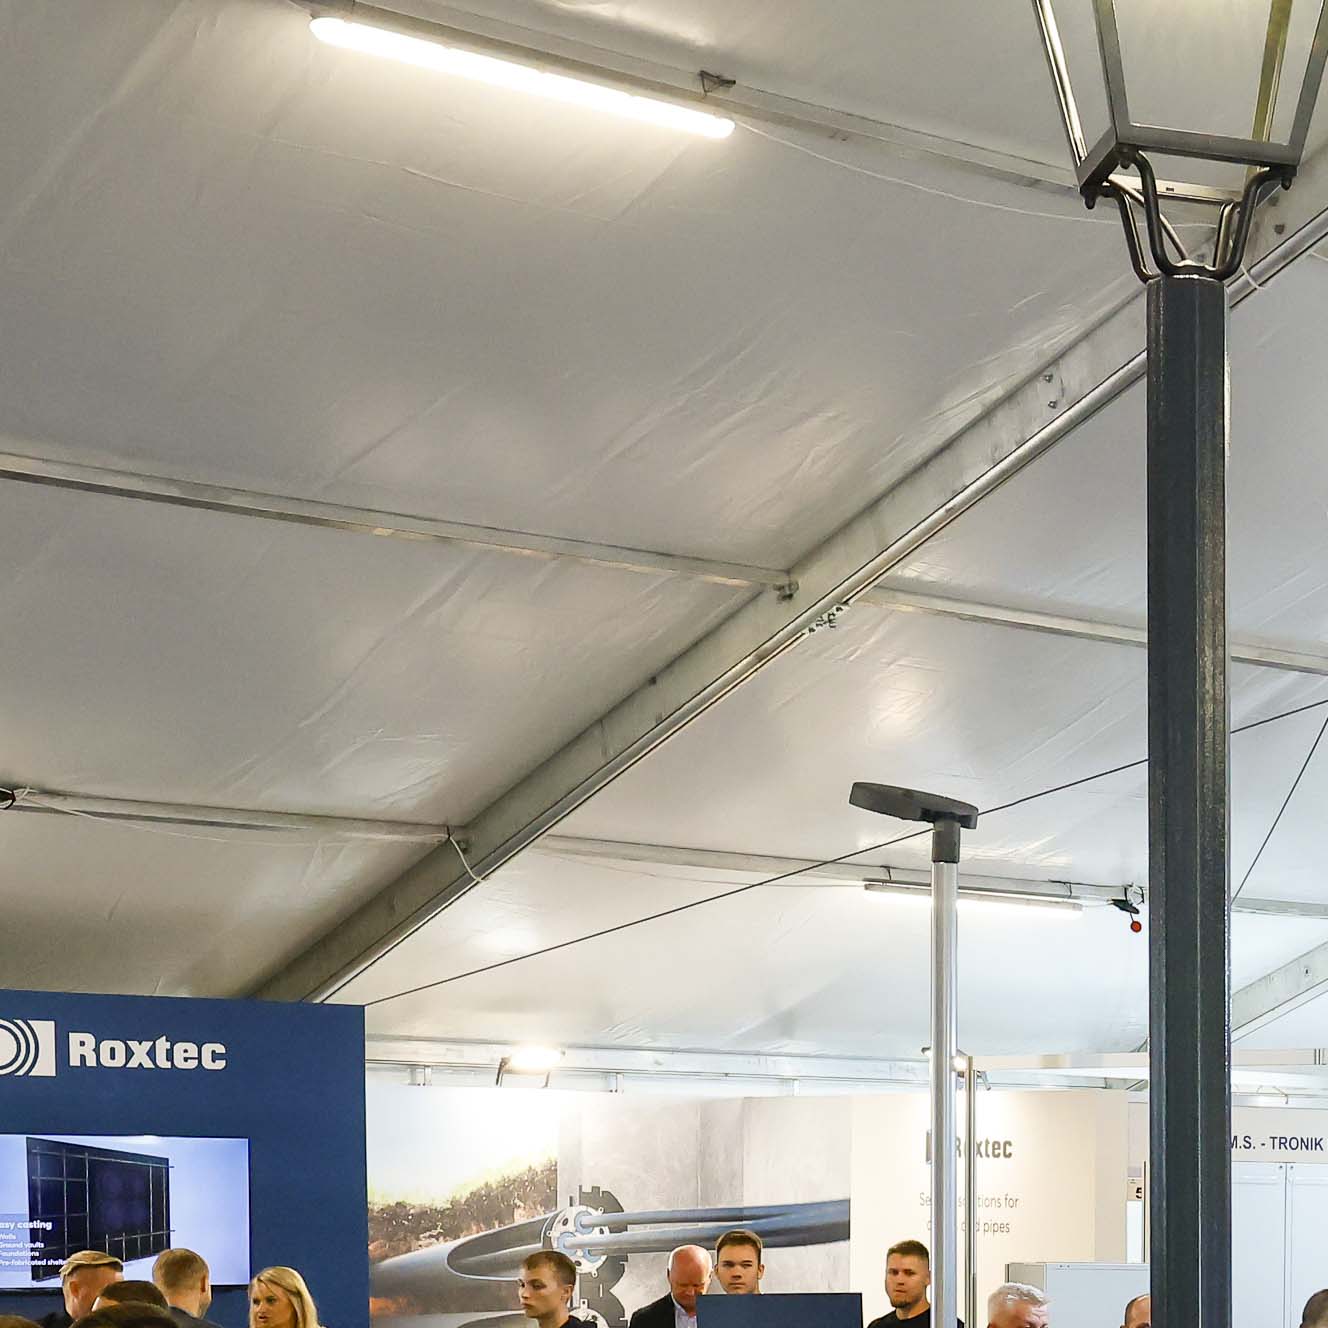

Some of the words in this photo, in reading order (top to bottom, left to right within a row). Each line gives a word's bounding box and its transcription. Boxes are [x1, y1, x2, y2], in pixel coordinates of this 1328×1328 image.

[68, 1032, 226, 1070] Roxtec
[1270, 1136, 1324, 1151] TRONIK
[983, 1220, 1010, 1237] pipes
